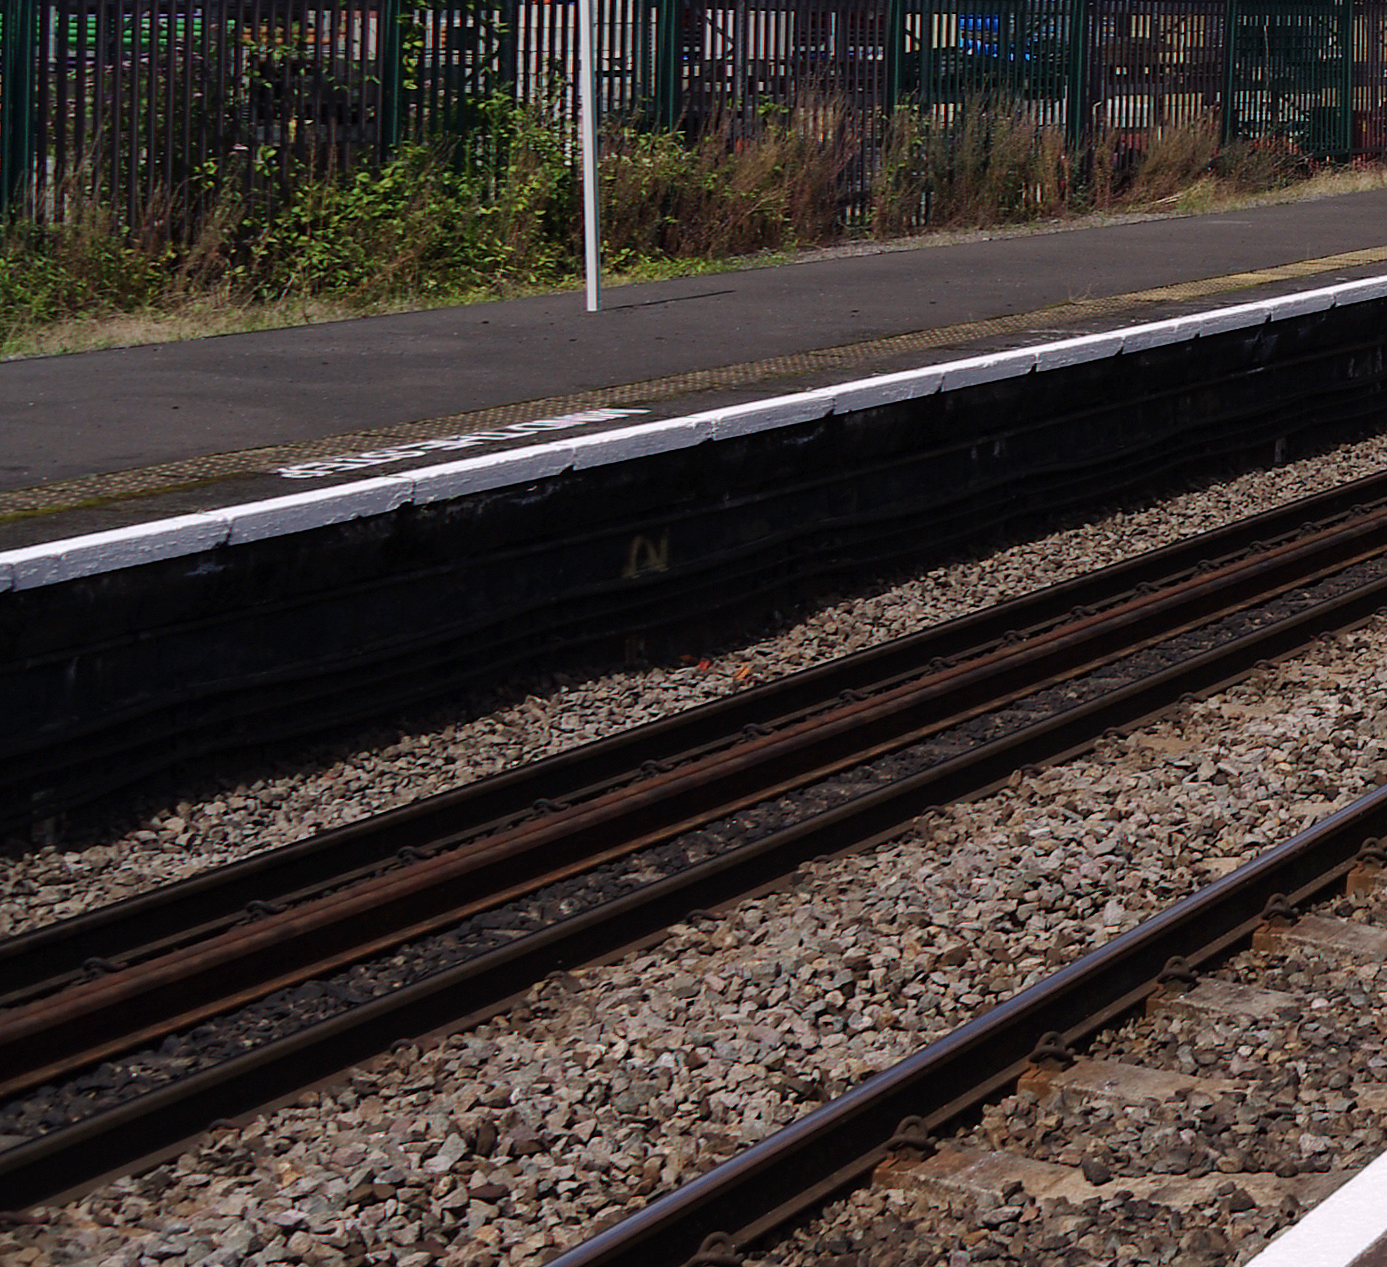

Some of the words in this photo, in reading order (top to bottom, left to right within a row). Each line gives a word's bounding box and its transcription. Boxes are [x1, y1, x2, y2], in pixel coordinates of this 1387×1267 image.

[505, 407, 652, 432] MIND
[382, 431, 539, 452] THE
[275, 449, 426, 478] STEP
